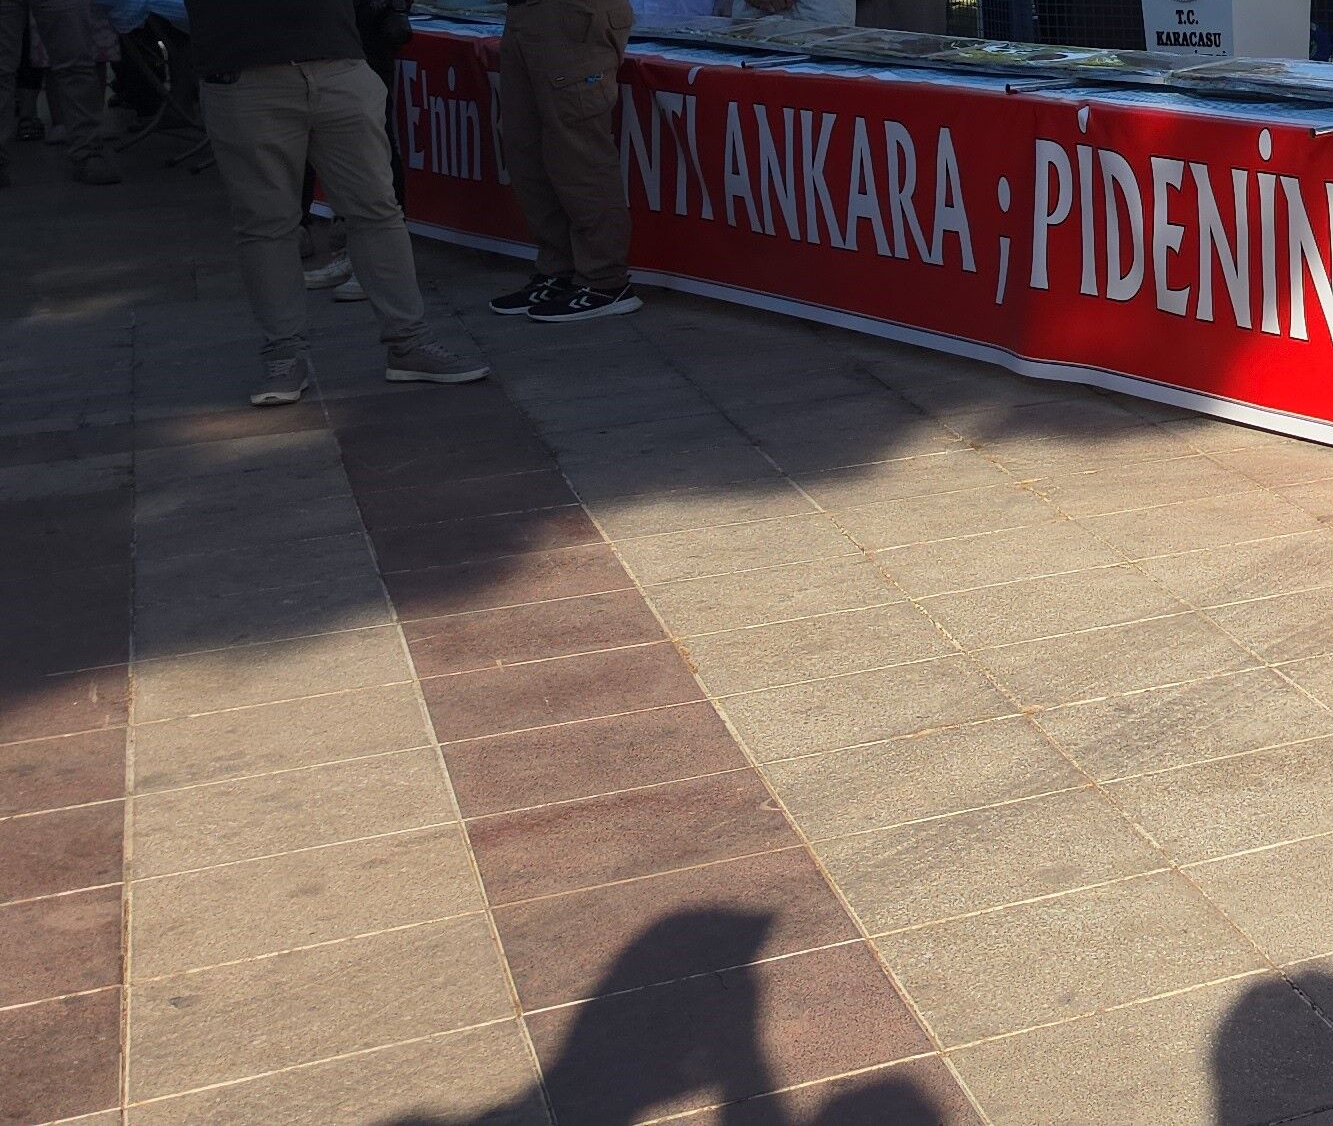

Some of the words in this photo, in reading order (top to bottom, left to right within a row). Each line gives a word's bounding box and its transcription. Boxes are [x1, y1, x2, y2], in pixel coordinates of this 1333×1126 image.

[1175, 9, 1199, 25] T.C.
[1155, 30, 1222, 48] KARACASU
[723, 99, 978, 273] ANKARA
